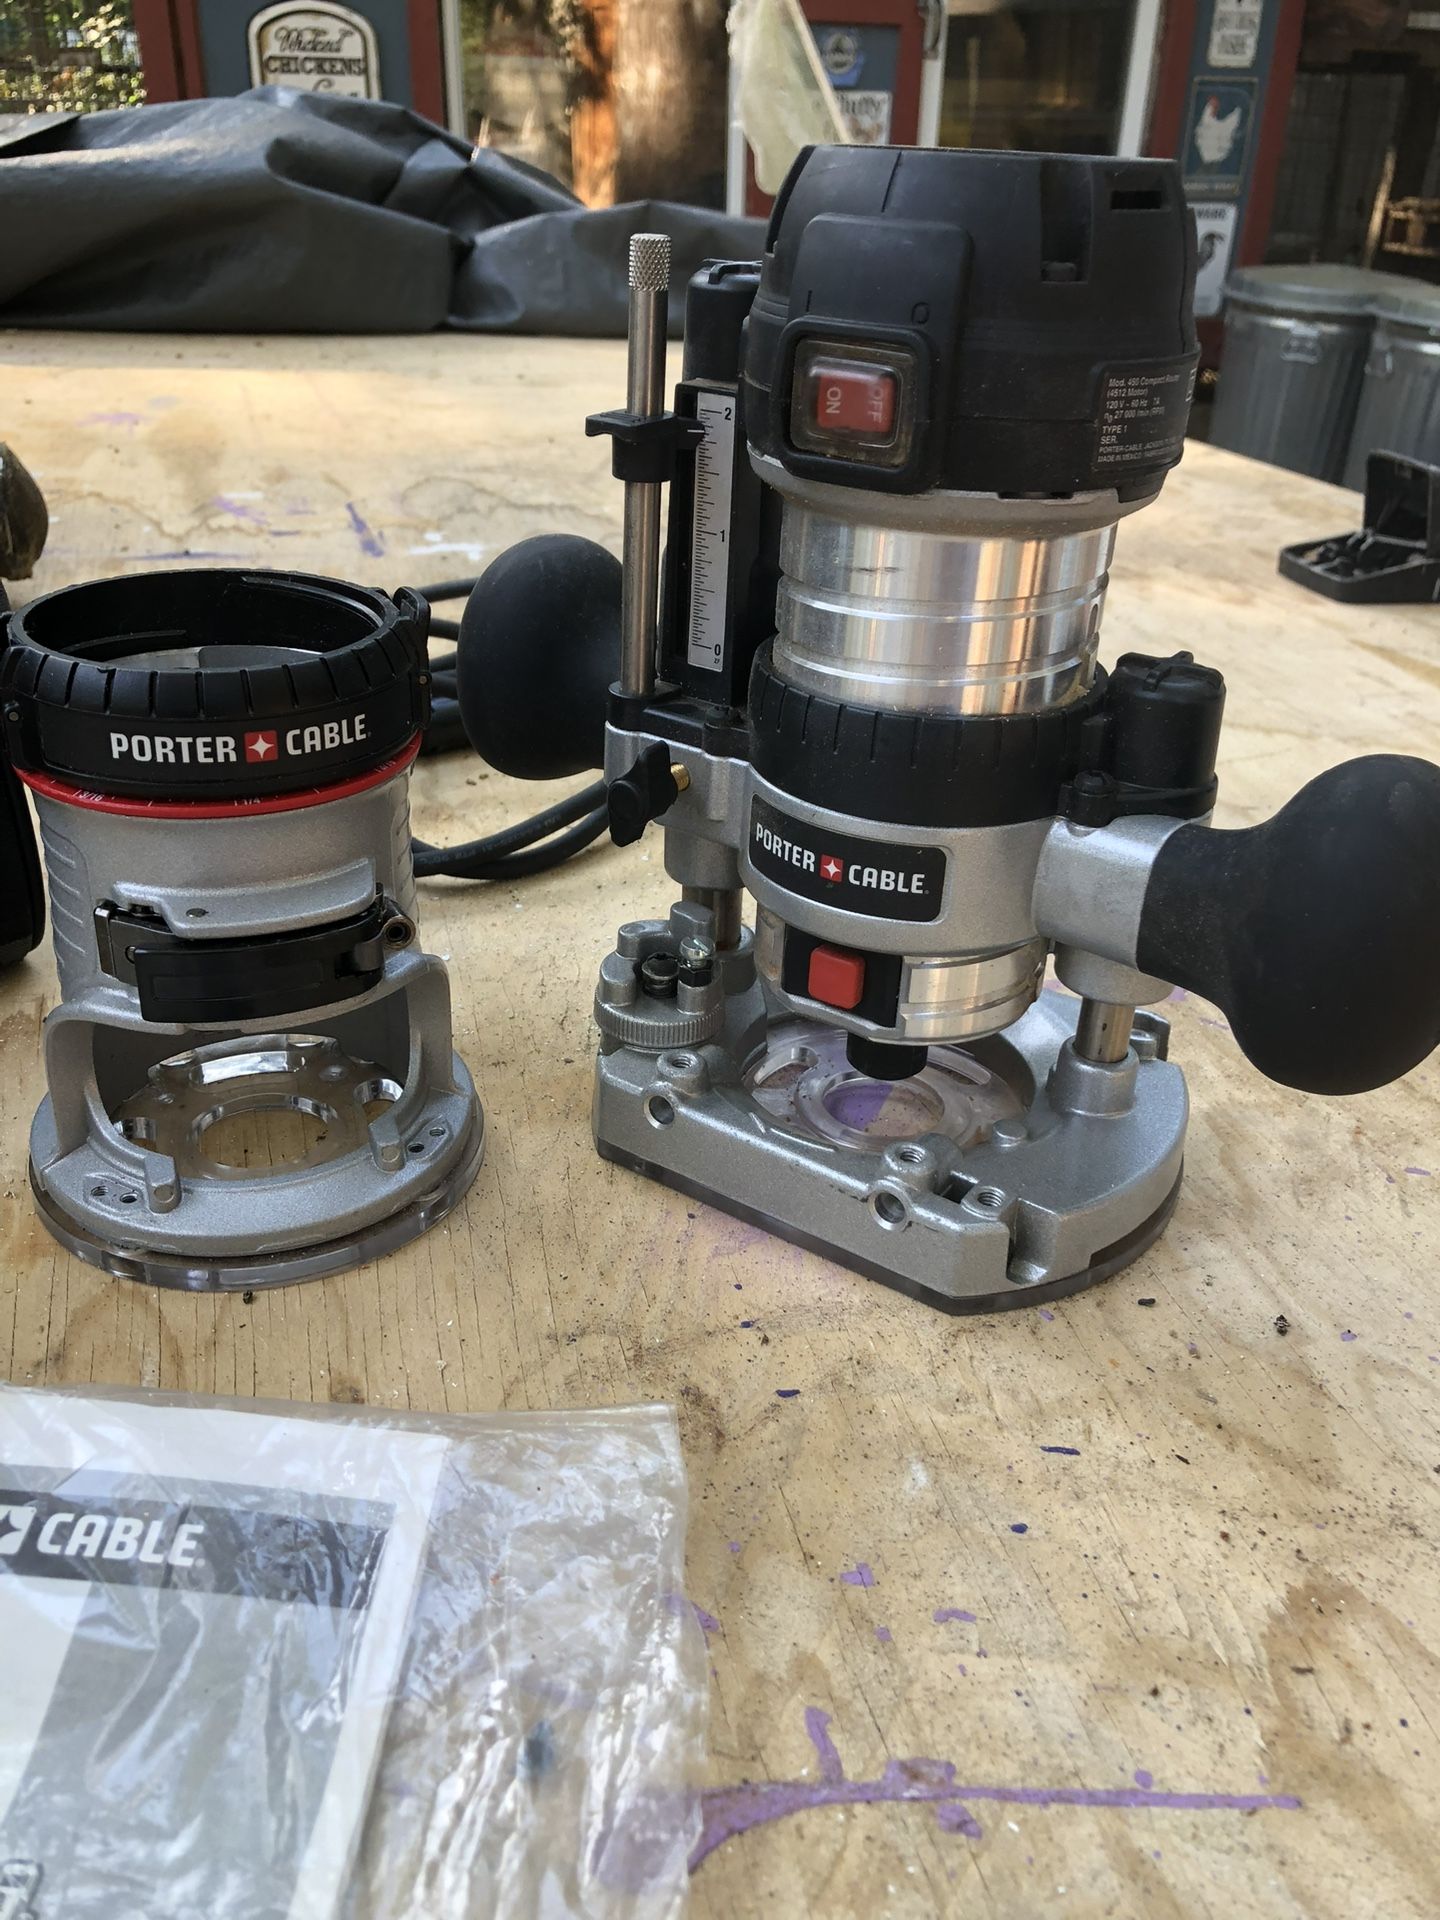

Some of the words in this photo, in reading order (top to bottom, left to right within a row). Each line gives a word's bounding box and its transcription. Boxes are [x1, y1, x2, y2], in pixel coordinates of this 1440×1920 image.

[265, 56, 363, 75] CHICKENS
[825, 386, 842, 414] ON
[867, 387, 884, 423] OFF
[724, 407, 732, 421] 2
[1102, 425, 1122, 434] TYPE
[719, 530, 726, 542] 1
[714, 644, 721, 656] 0
[110, 732, 237, 763] PORTER
[285, 713, 367, 756] CABLE
[755, 822, 816, 873] PORTER
[849, 865, 926, 895] CABLE
[36, 1512, 206, 1568] CABLE
